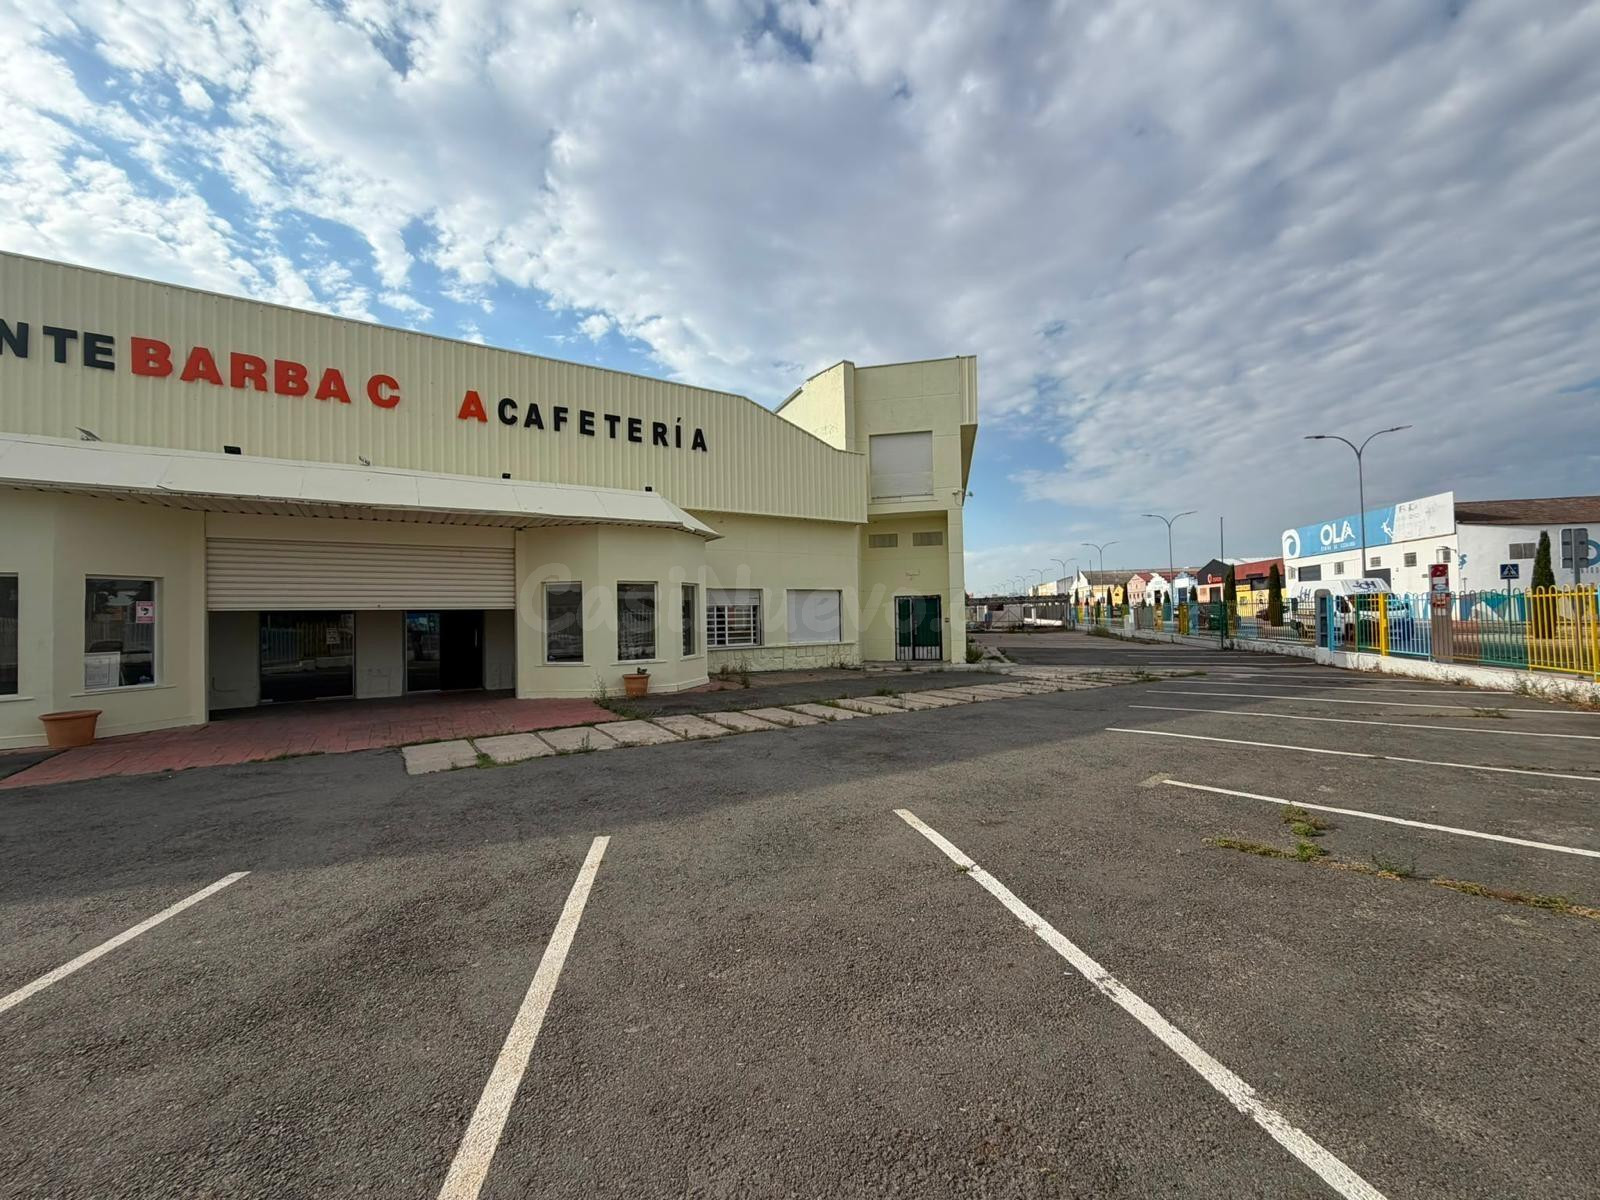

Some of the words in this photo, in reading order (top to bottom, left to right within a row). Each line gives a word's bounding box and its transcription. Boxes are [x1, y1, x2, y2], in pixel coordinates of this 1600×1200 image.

[0, 319, 115, 371] NTE
[498, 398, 708, 452] CAFETERÍA
[1320, 520, 1356, 546] OLA
